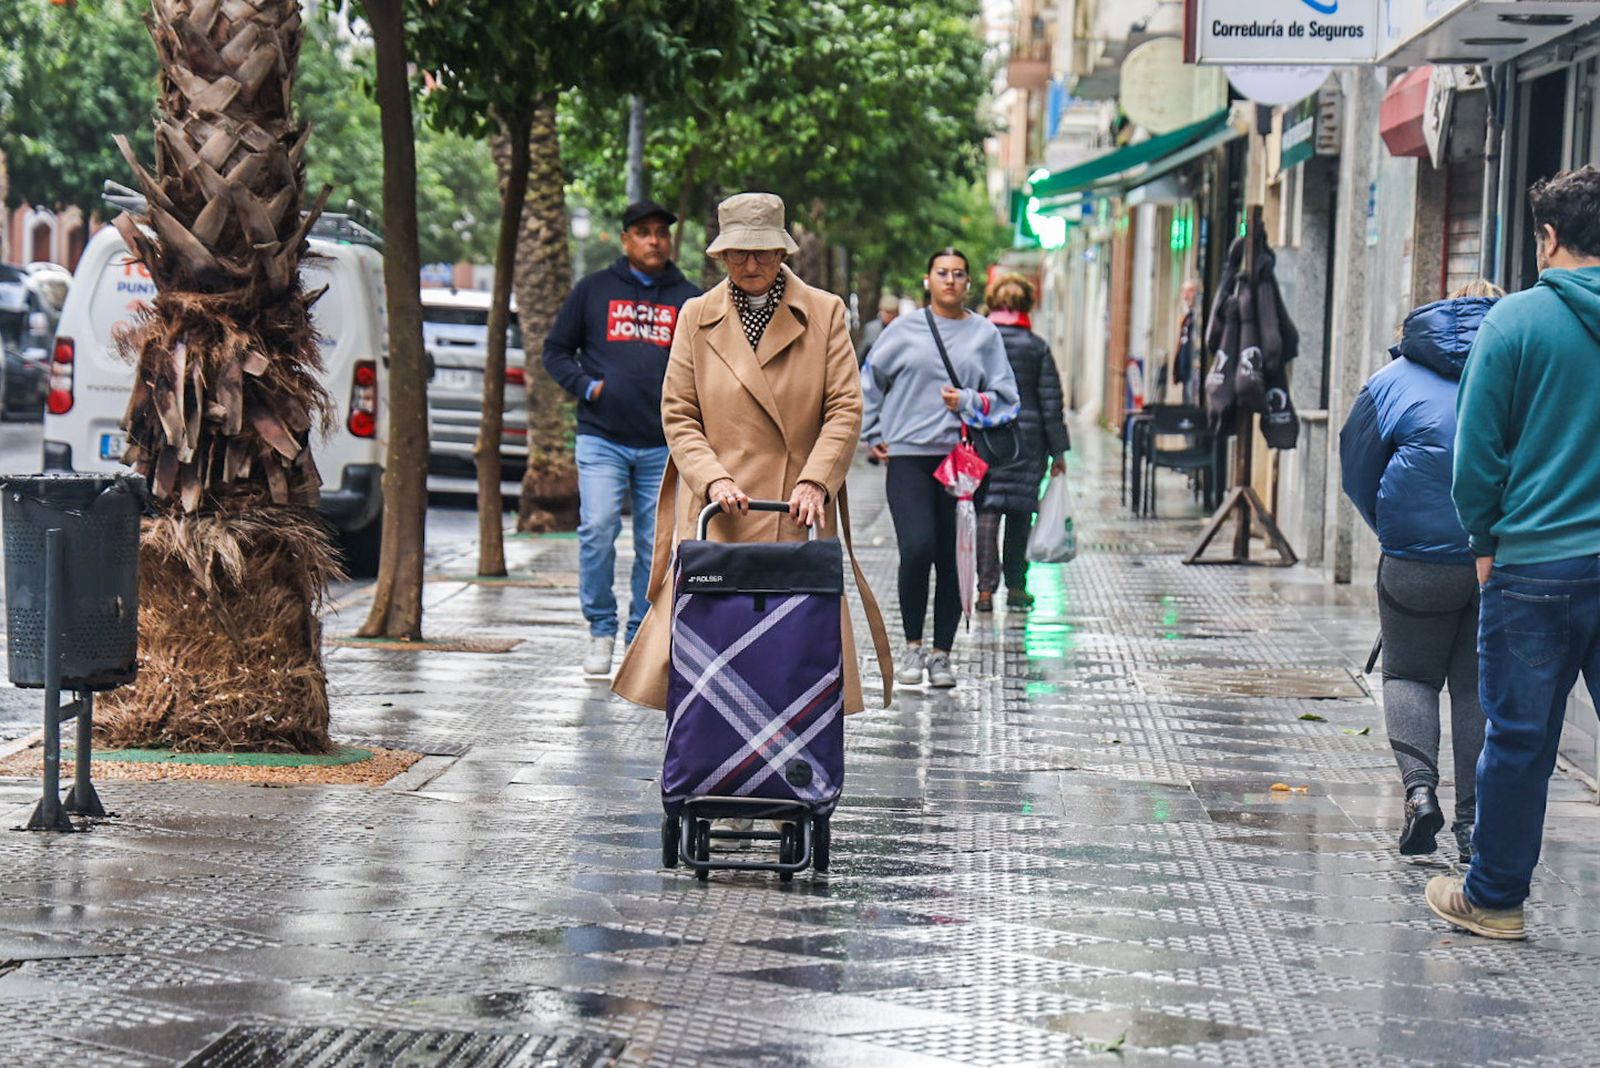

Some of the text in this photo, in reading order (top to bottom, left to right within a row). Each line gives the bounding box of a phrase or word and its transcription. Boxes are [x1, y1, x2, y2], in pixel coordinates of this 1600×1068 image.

[1212, 19, 1364, 41] Correduría de Seguros
[610, 321, 671, 342] JONES
